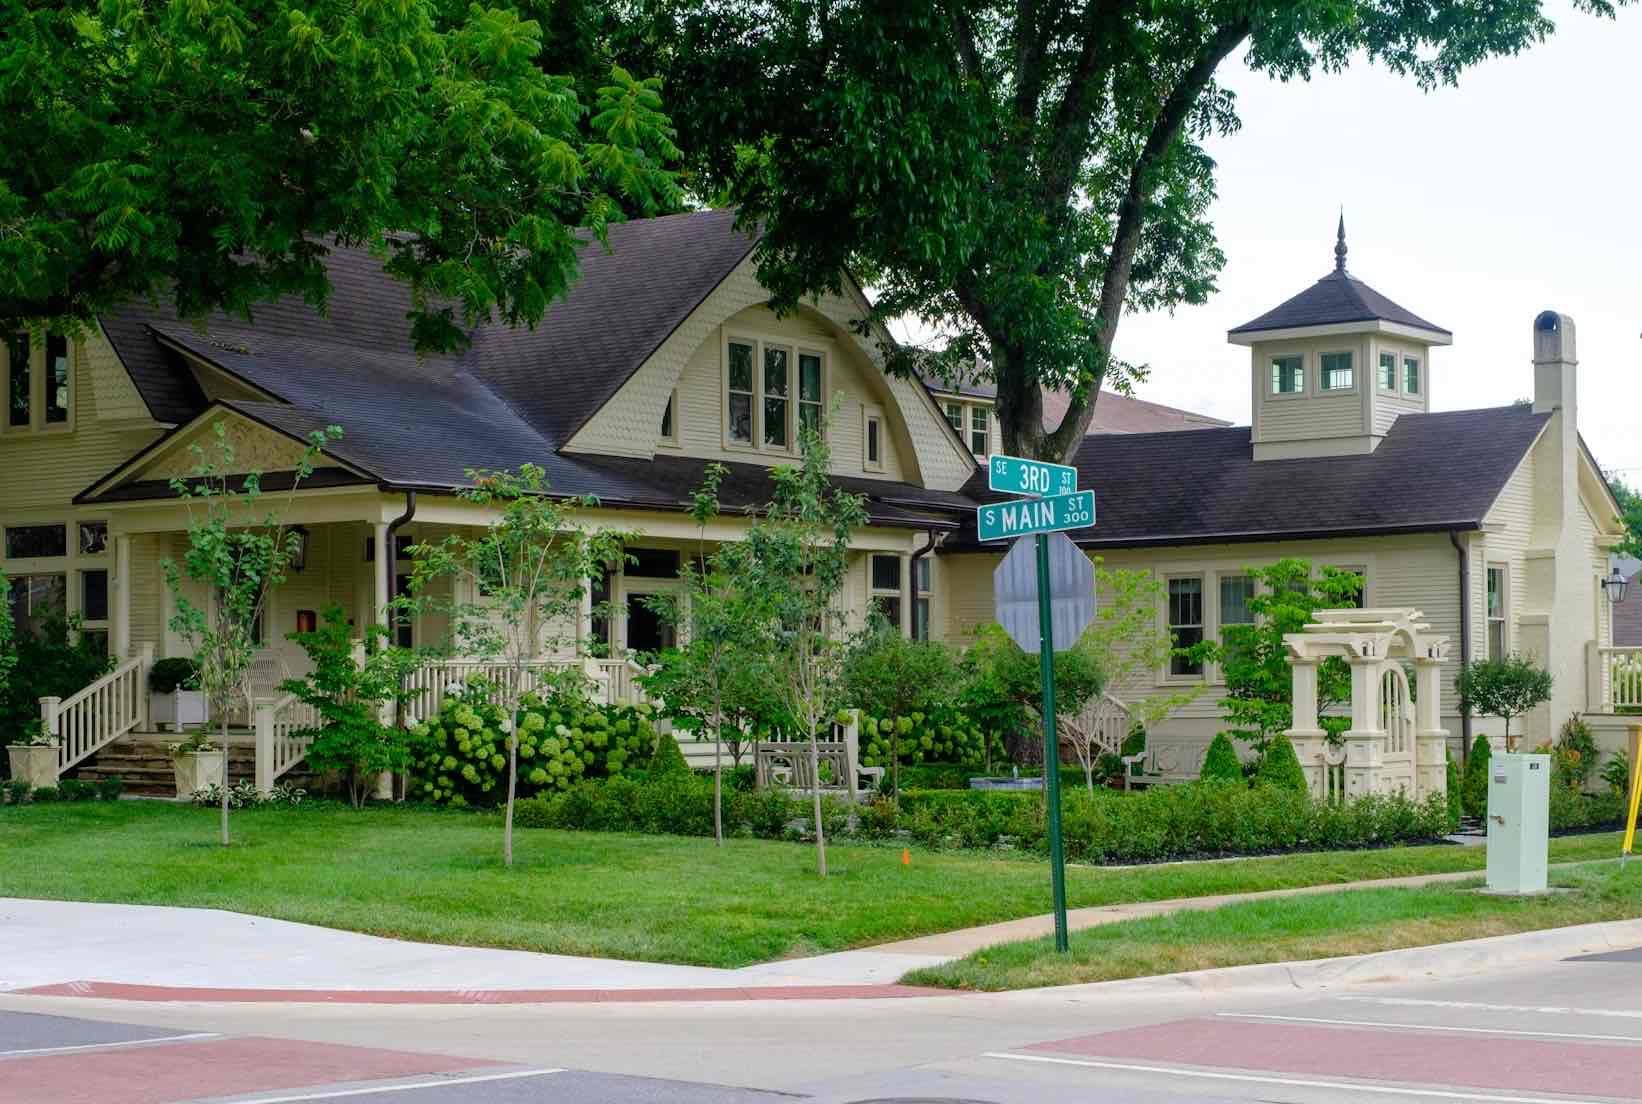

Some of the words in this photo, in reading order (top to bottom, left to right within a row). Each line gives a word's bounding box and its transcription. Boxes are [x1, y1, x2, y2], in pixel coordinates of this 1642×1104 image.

[995, 461, 1007, 475] SE
[1020, 464, 1050, 492] 3RD
[1061, 471, 1071, 485] ST
[985, 510, 995, 526] S
[1001, 501, 1055, 533] MAIN
[1068, 496, 1084, 512] ST
[1063, 511, 1089, 524] 300
